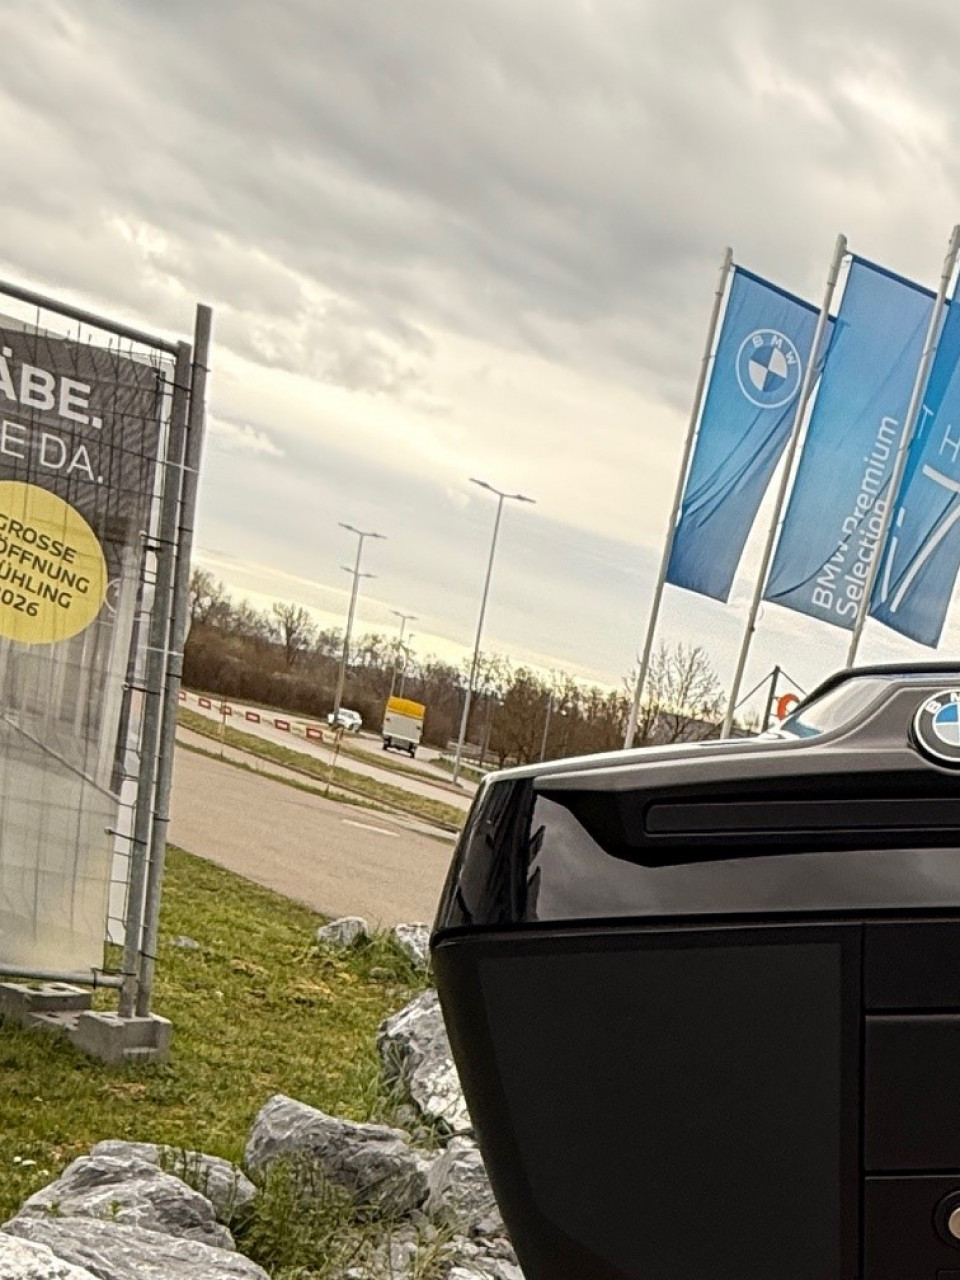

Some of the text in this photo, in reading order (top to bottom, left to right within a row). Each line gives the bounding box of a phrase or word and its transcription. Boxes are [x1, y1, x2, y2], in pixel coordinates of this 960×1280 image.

[39, 431, 104, 483] DA.
[842, 415, 899, 535] Premium
[0, 587, 39, 617] 026
[836, 500, 888, 619] Selection
